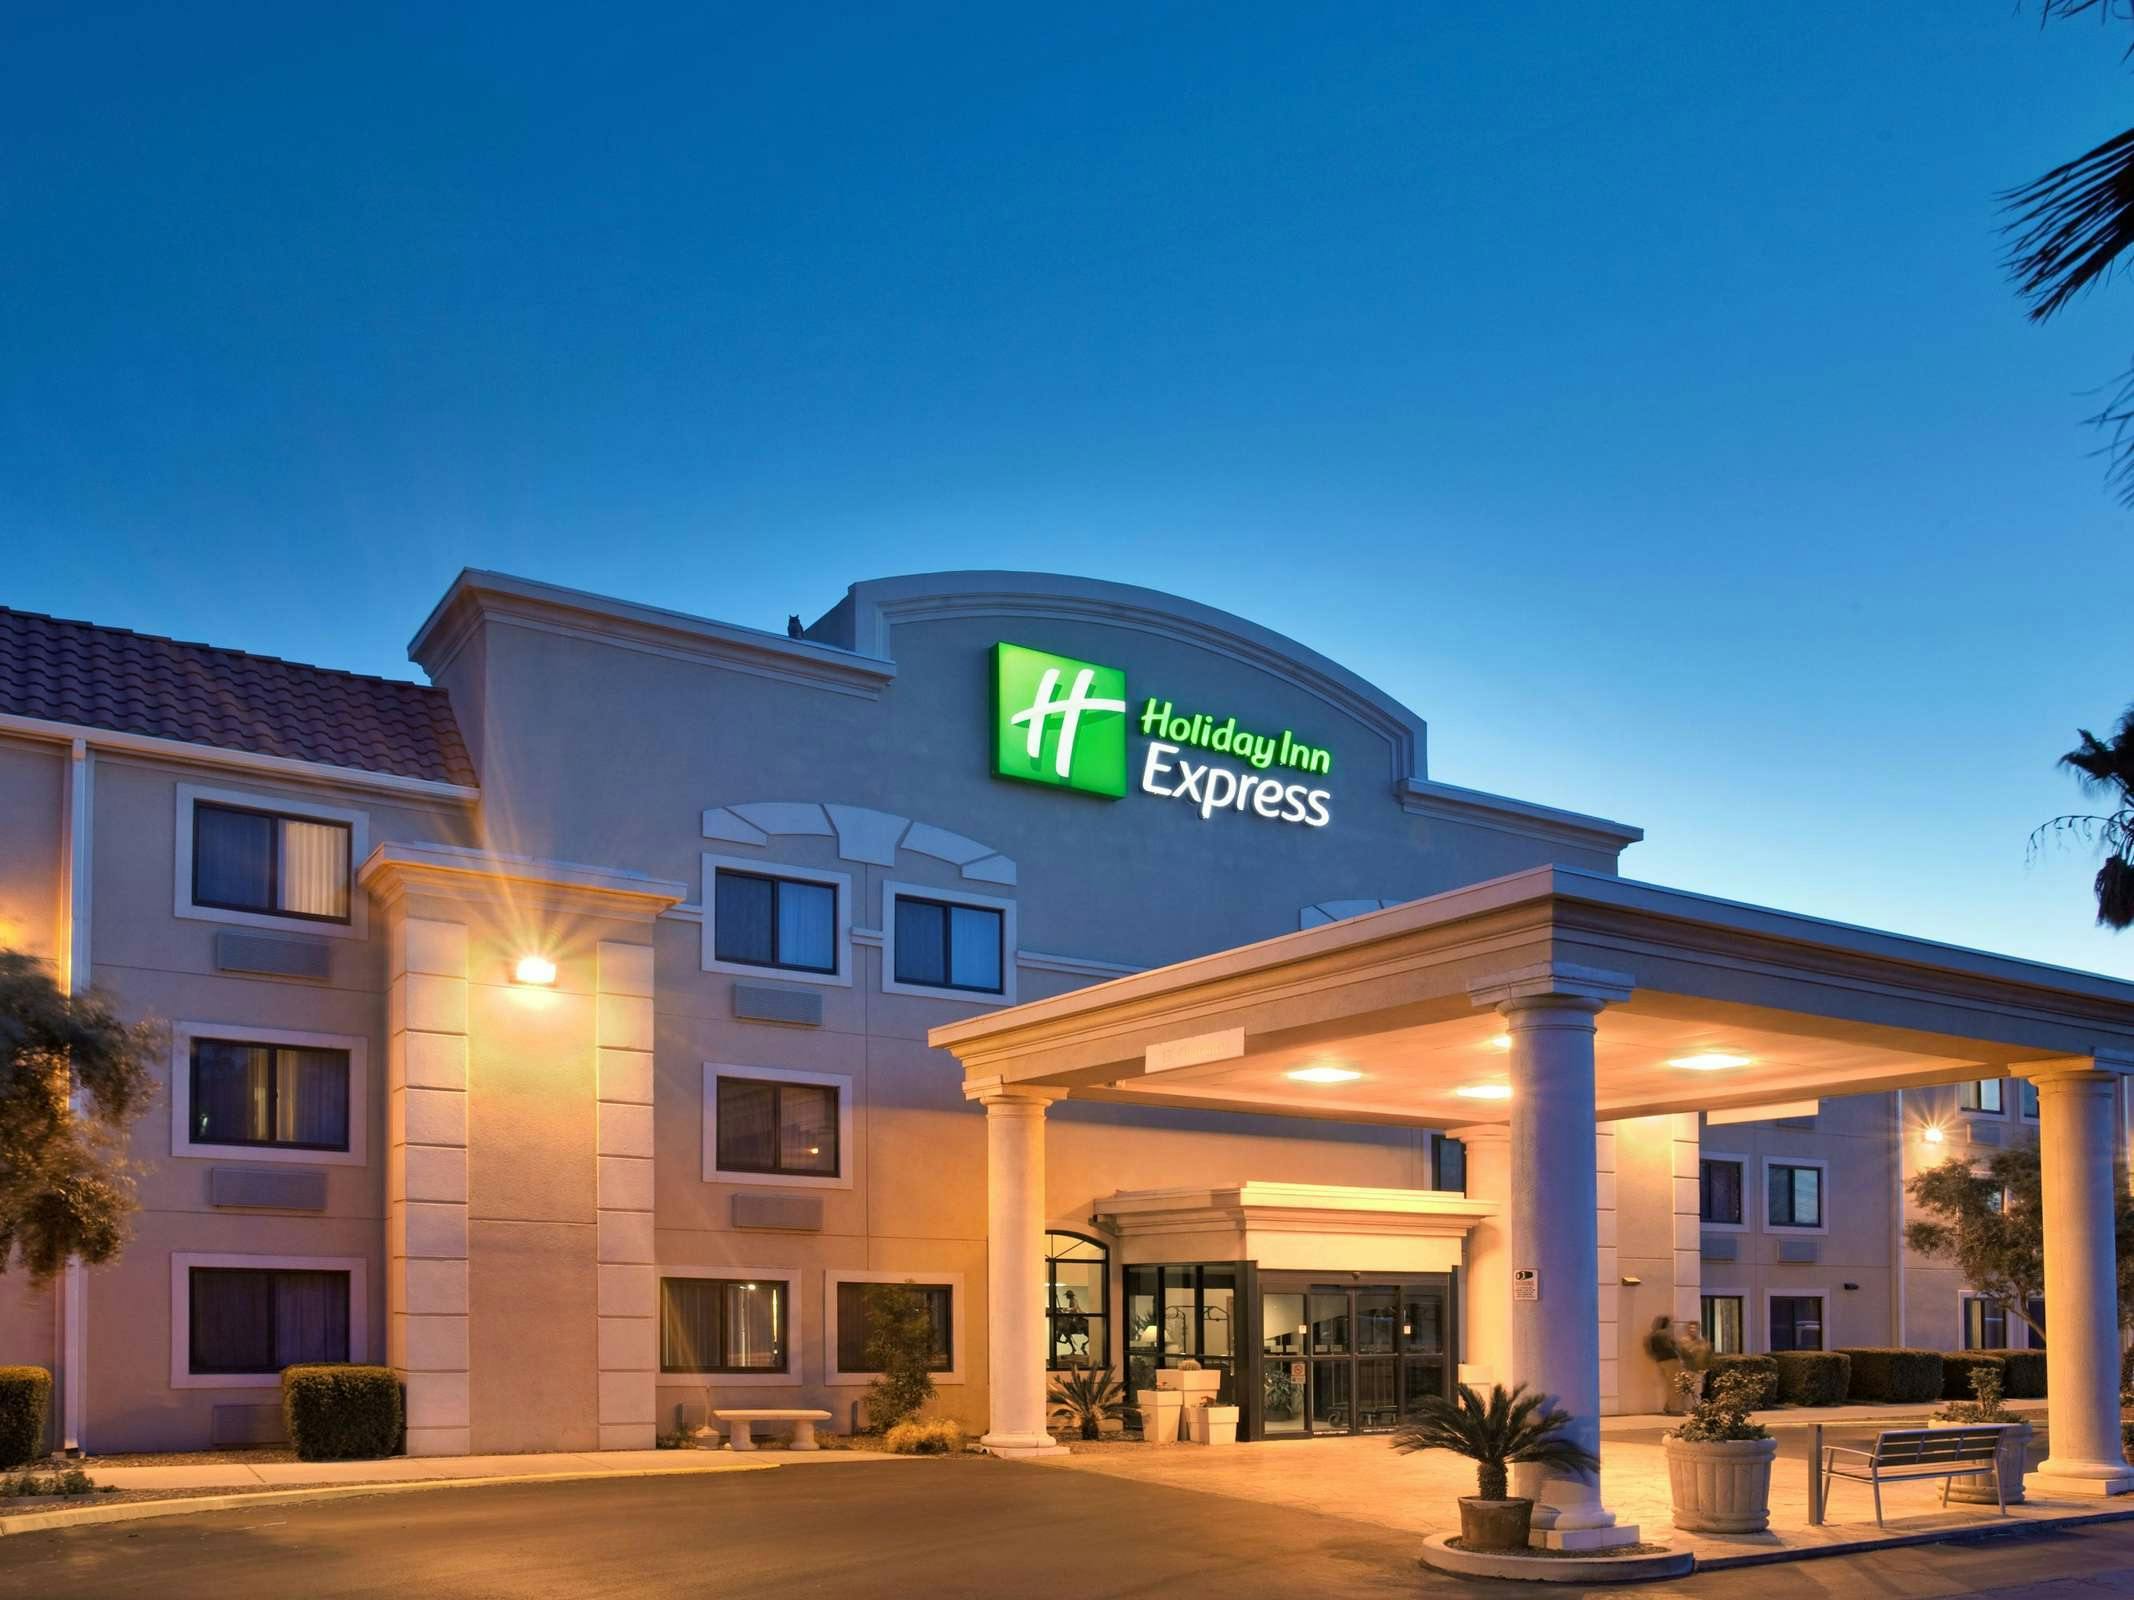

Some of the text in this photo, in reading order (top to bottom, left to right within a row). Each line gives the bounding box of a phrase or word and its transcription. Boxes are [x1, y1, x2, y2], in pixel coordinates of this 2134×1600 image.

[1141, 697, 1331, 774] Holiday Inn
[1141, 741, 1331, 828] Express
